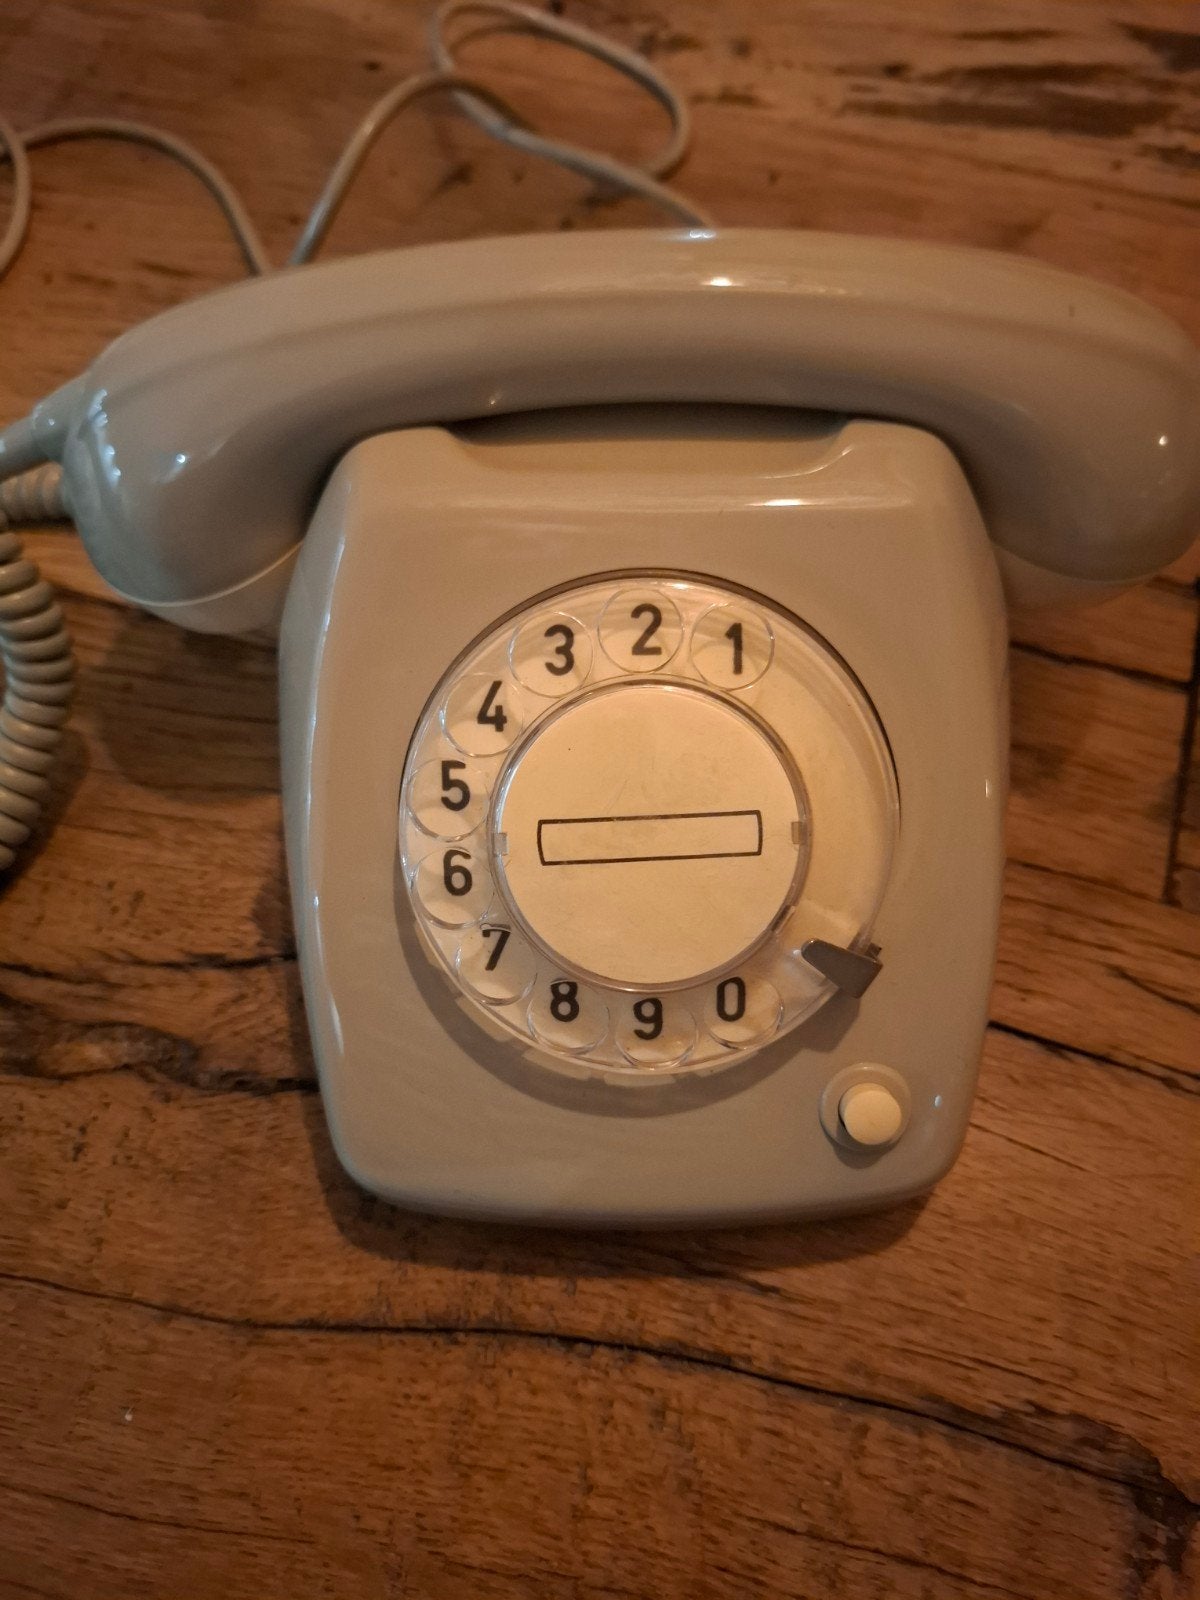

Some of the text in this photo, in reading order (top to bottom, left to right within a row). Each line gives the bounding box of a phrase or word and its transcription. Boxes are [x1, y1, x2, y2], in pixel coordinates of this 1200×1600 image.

[545, 624, 574, 675] 3
[631, 603, 662, 655] 2
[724, 623, 743, 675] 1
[477, 681, 507, 732] 4
[441, 760, 471, 811] 5
[444, 849, 473, 897] 6
[482, 926, 511, 971] 7
[550, 980, 579, 1022] 8
[633, 997, 663, 1041] 9
[717, 977, 746, 1022] 0
